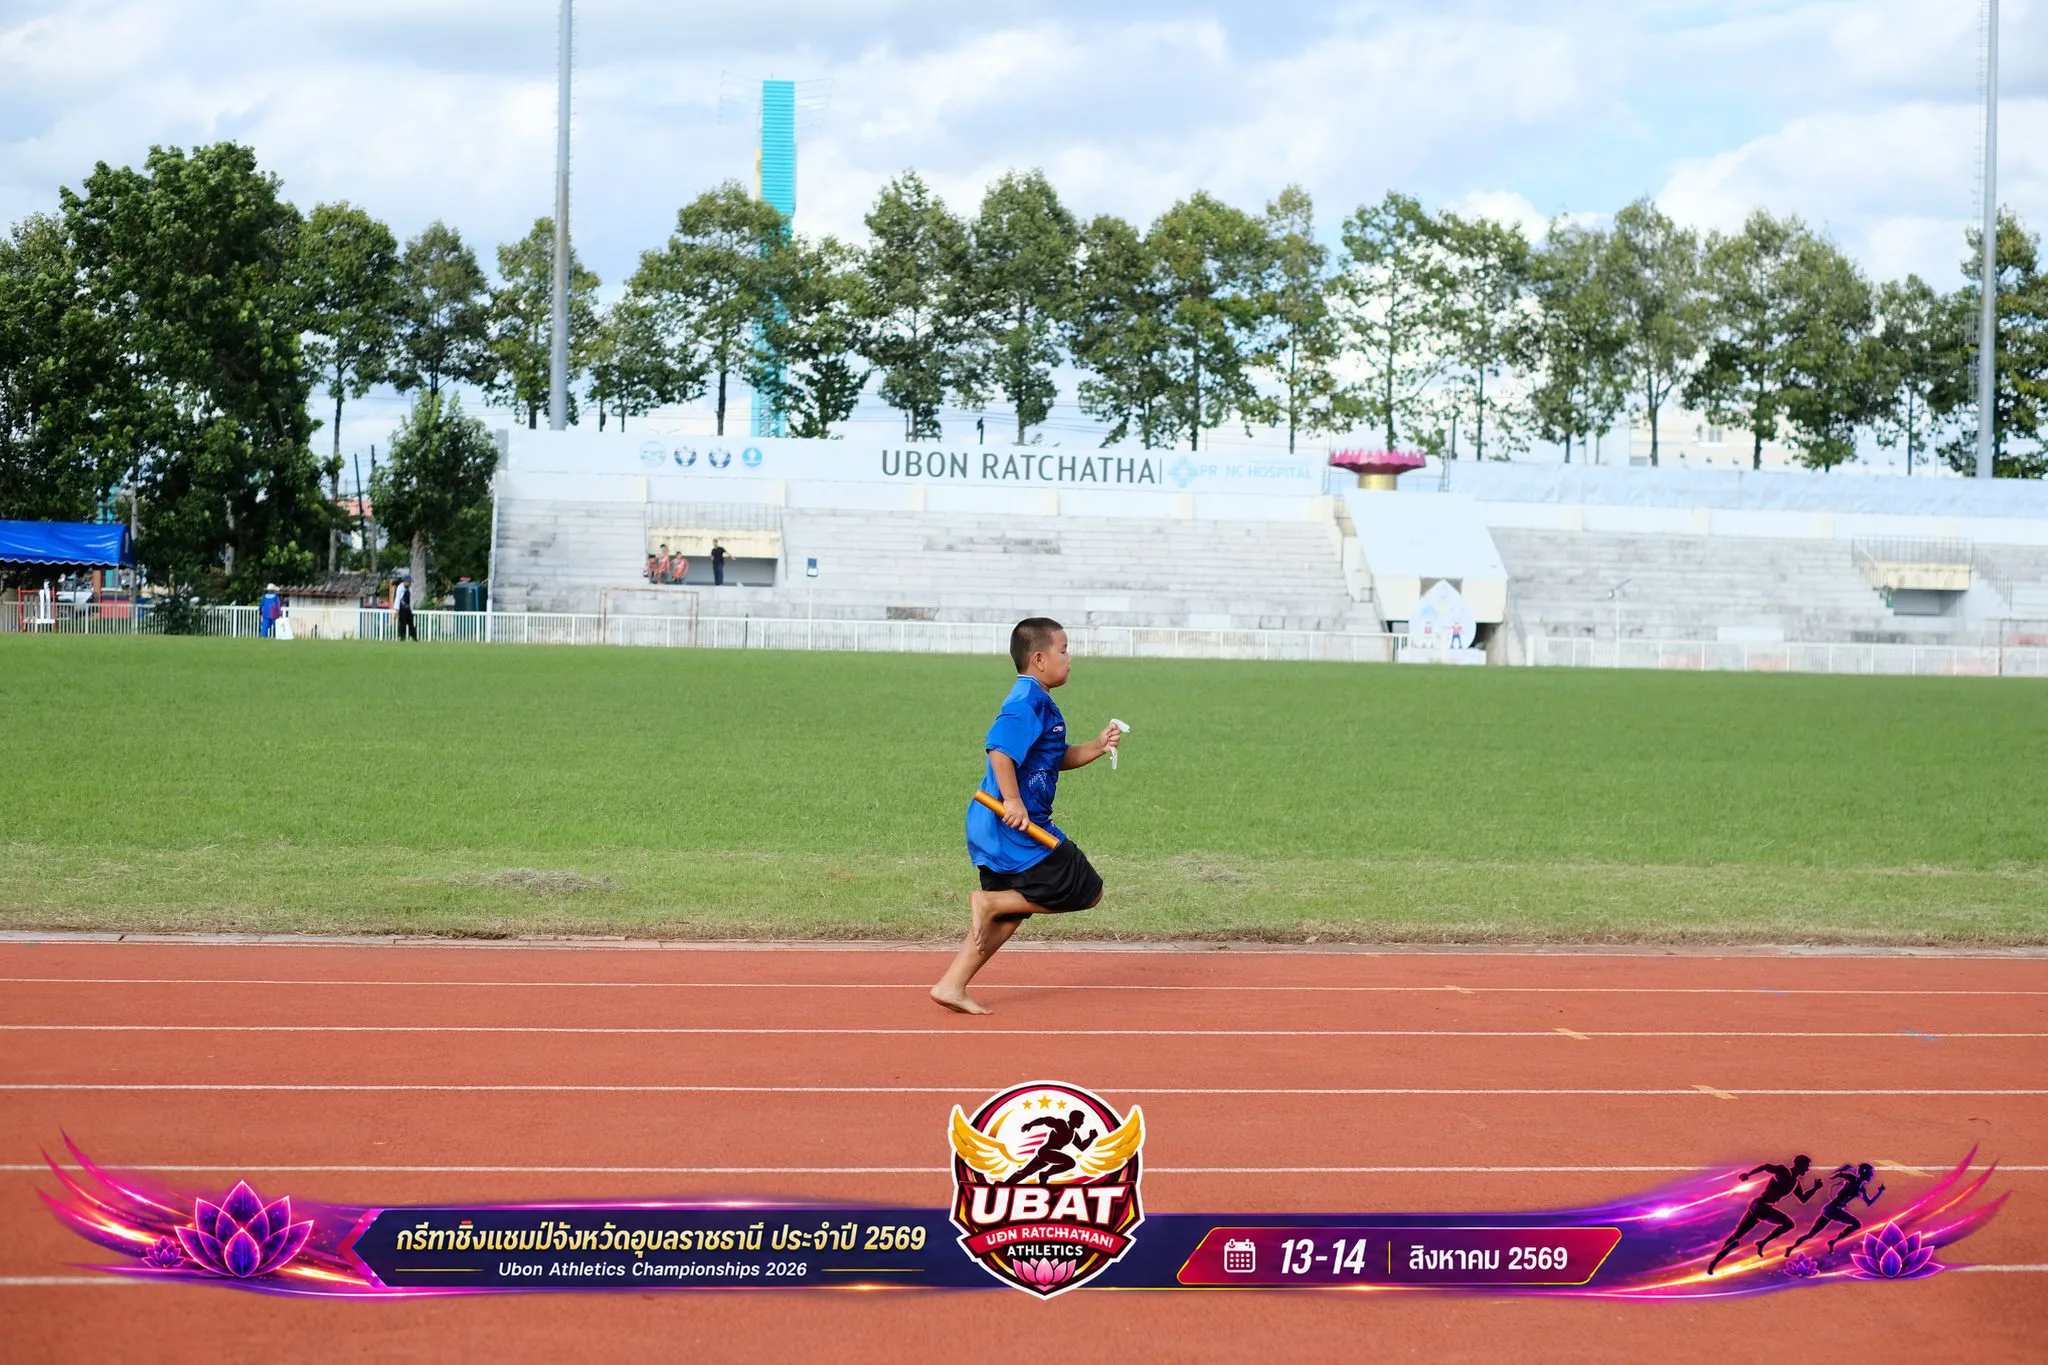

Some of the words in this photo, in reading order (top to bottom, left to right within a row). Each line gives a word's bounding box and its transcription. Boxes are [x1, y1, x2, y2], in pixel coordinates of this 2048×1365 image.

[881, 450, 969, 479] UBON
[981, 453, 1162, 485] RATCHATHA
[1248, 465, 1314, 480] HOSPITAL
